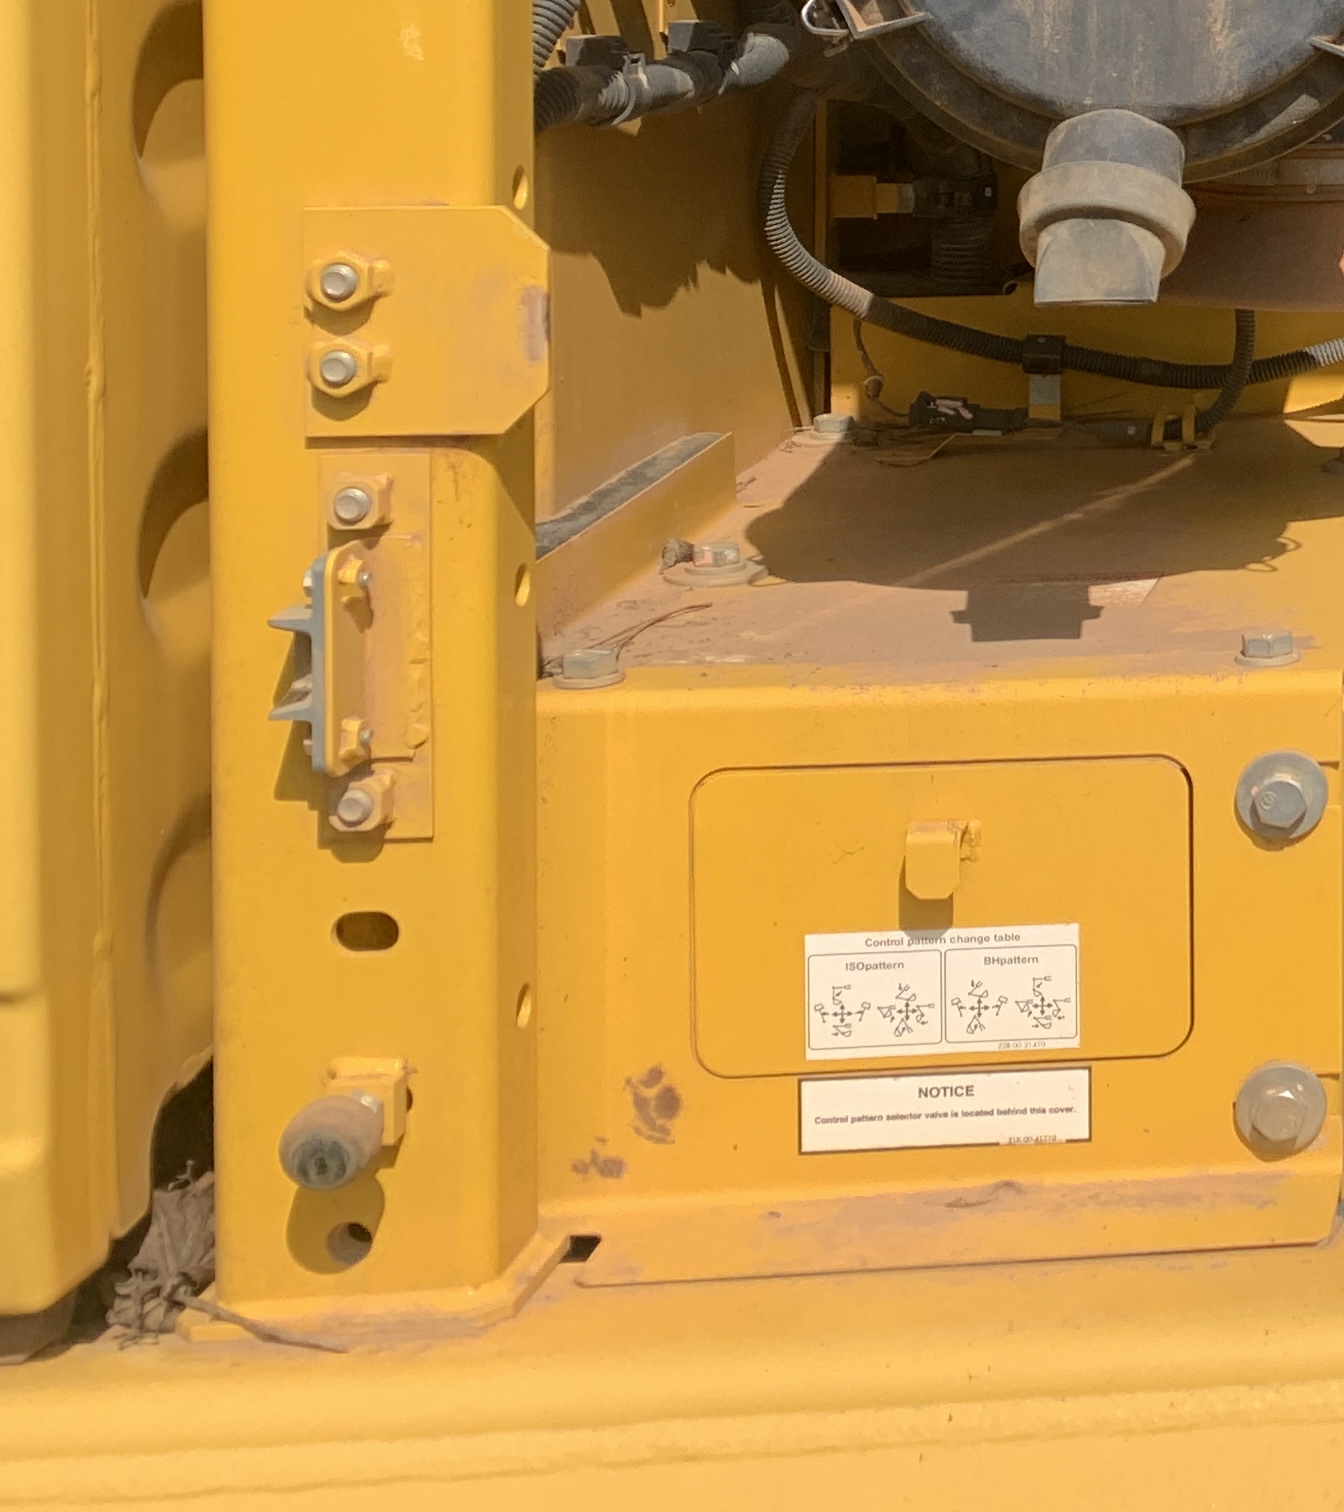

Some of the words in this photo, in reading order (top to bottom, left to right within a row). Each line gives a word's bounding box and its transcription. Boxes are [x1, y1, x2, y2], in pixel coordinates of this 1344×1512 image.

[864, 937, 904, 948] Control
[907, 936, 946, 948] pattern
[949, 934, 990, 945] change
[994, 932, 1020, 942] table
[845, 960, 905, 972] ISOpattern
[984, 955, 1039, 967] BHpattern
[918, 1085, 975, 1099] NOTICE
[814, 1115, 848, 1125] Control
[851, 1114, 883, 1124] pattern
[886, 1112, 922, 1121] selector
[924, 1110, 949, 1119] valve
[950, 1109, 959, 1118] is
[961, 1108, 994, 1118] located
[996, 1107, 1027, 1116] behind
[1030, 1106, 1047, 1115] this
[1048, 1106, 1077, 1114] cover.
